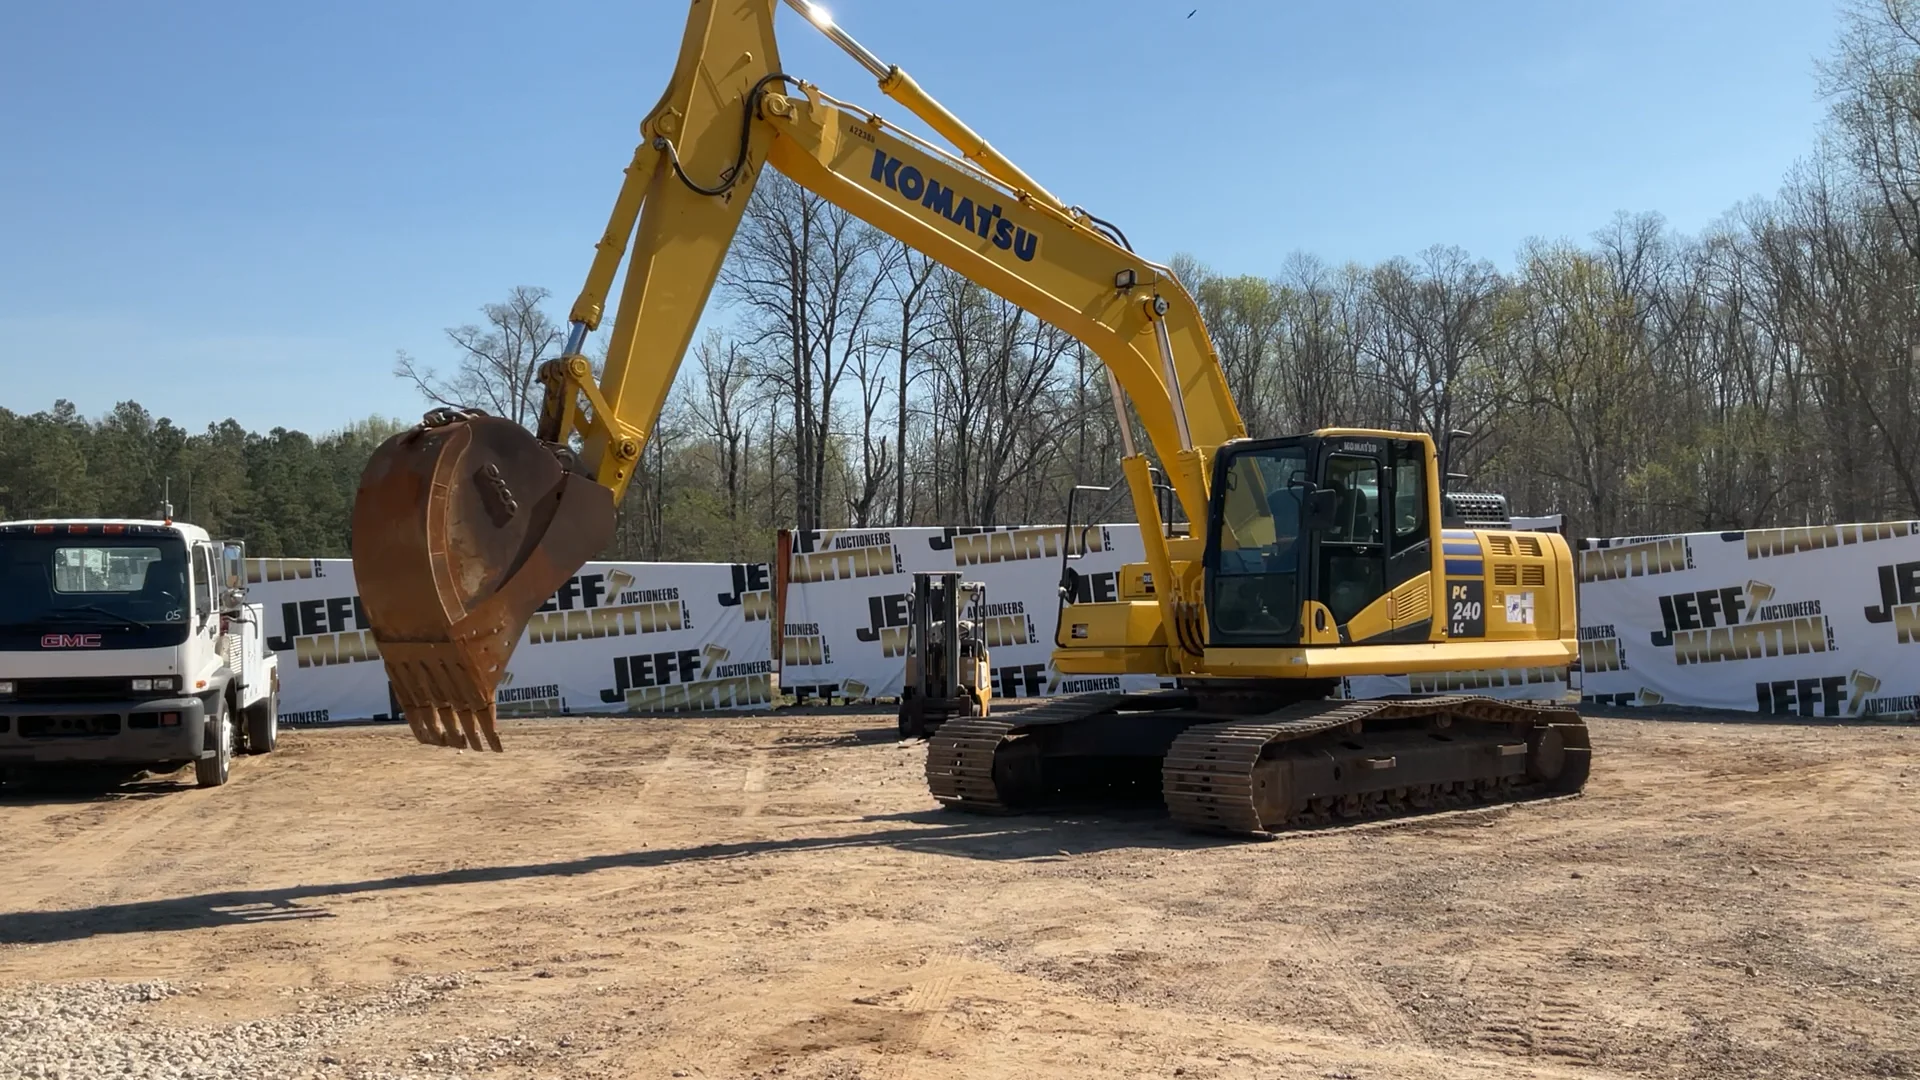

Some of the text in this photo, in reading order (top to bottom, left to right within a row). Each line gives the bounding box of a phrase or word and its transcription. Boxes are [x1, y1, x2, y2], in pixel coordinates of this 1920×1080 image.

[870, 148, 1038, 262] KOMATSU
[835, 532, 891, 550] AUCTIONEERS
[789, 545, 894, 583] ARTIN
[1580, 538, 1685, 583] ARTIN
[718, 564, 771, 607] JE
[1452, 585, 1467, 600] PC
[1864, 561, 1920, 623] JE
[621, 588, 679, 604] AUCTIONEERS
[1452, 602, 1481, 620] 240
[1651, 586, 1746, 647] JEFF
[1760, 600, 1822, 621] AUCTIONEERS
[528, 601, 681, 645] MARTIN
[1453, 622, 1464, 634] LC
[41, 634, 101, 647] GMC
[1580, 624, 1616, 641] TIONEERS
[1674, 616, 1826, 665] MARTIN
[600, 649, 701, 703] JEFF
[716, 660, 771, 678] AUCTIONEERS
[499, 684, 559, 702] AUCTIONEERS
[1061, 676, 1120, 694] AUCTIONEERS
[1865, 695, 1920, 713] AUCTIONEER
